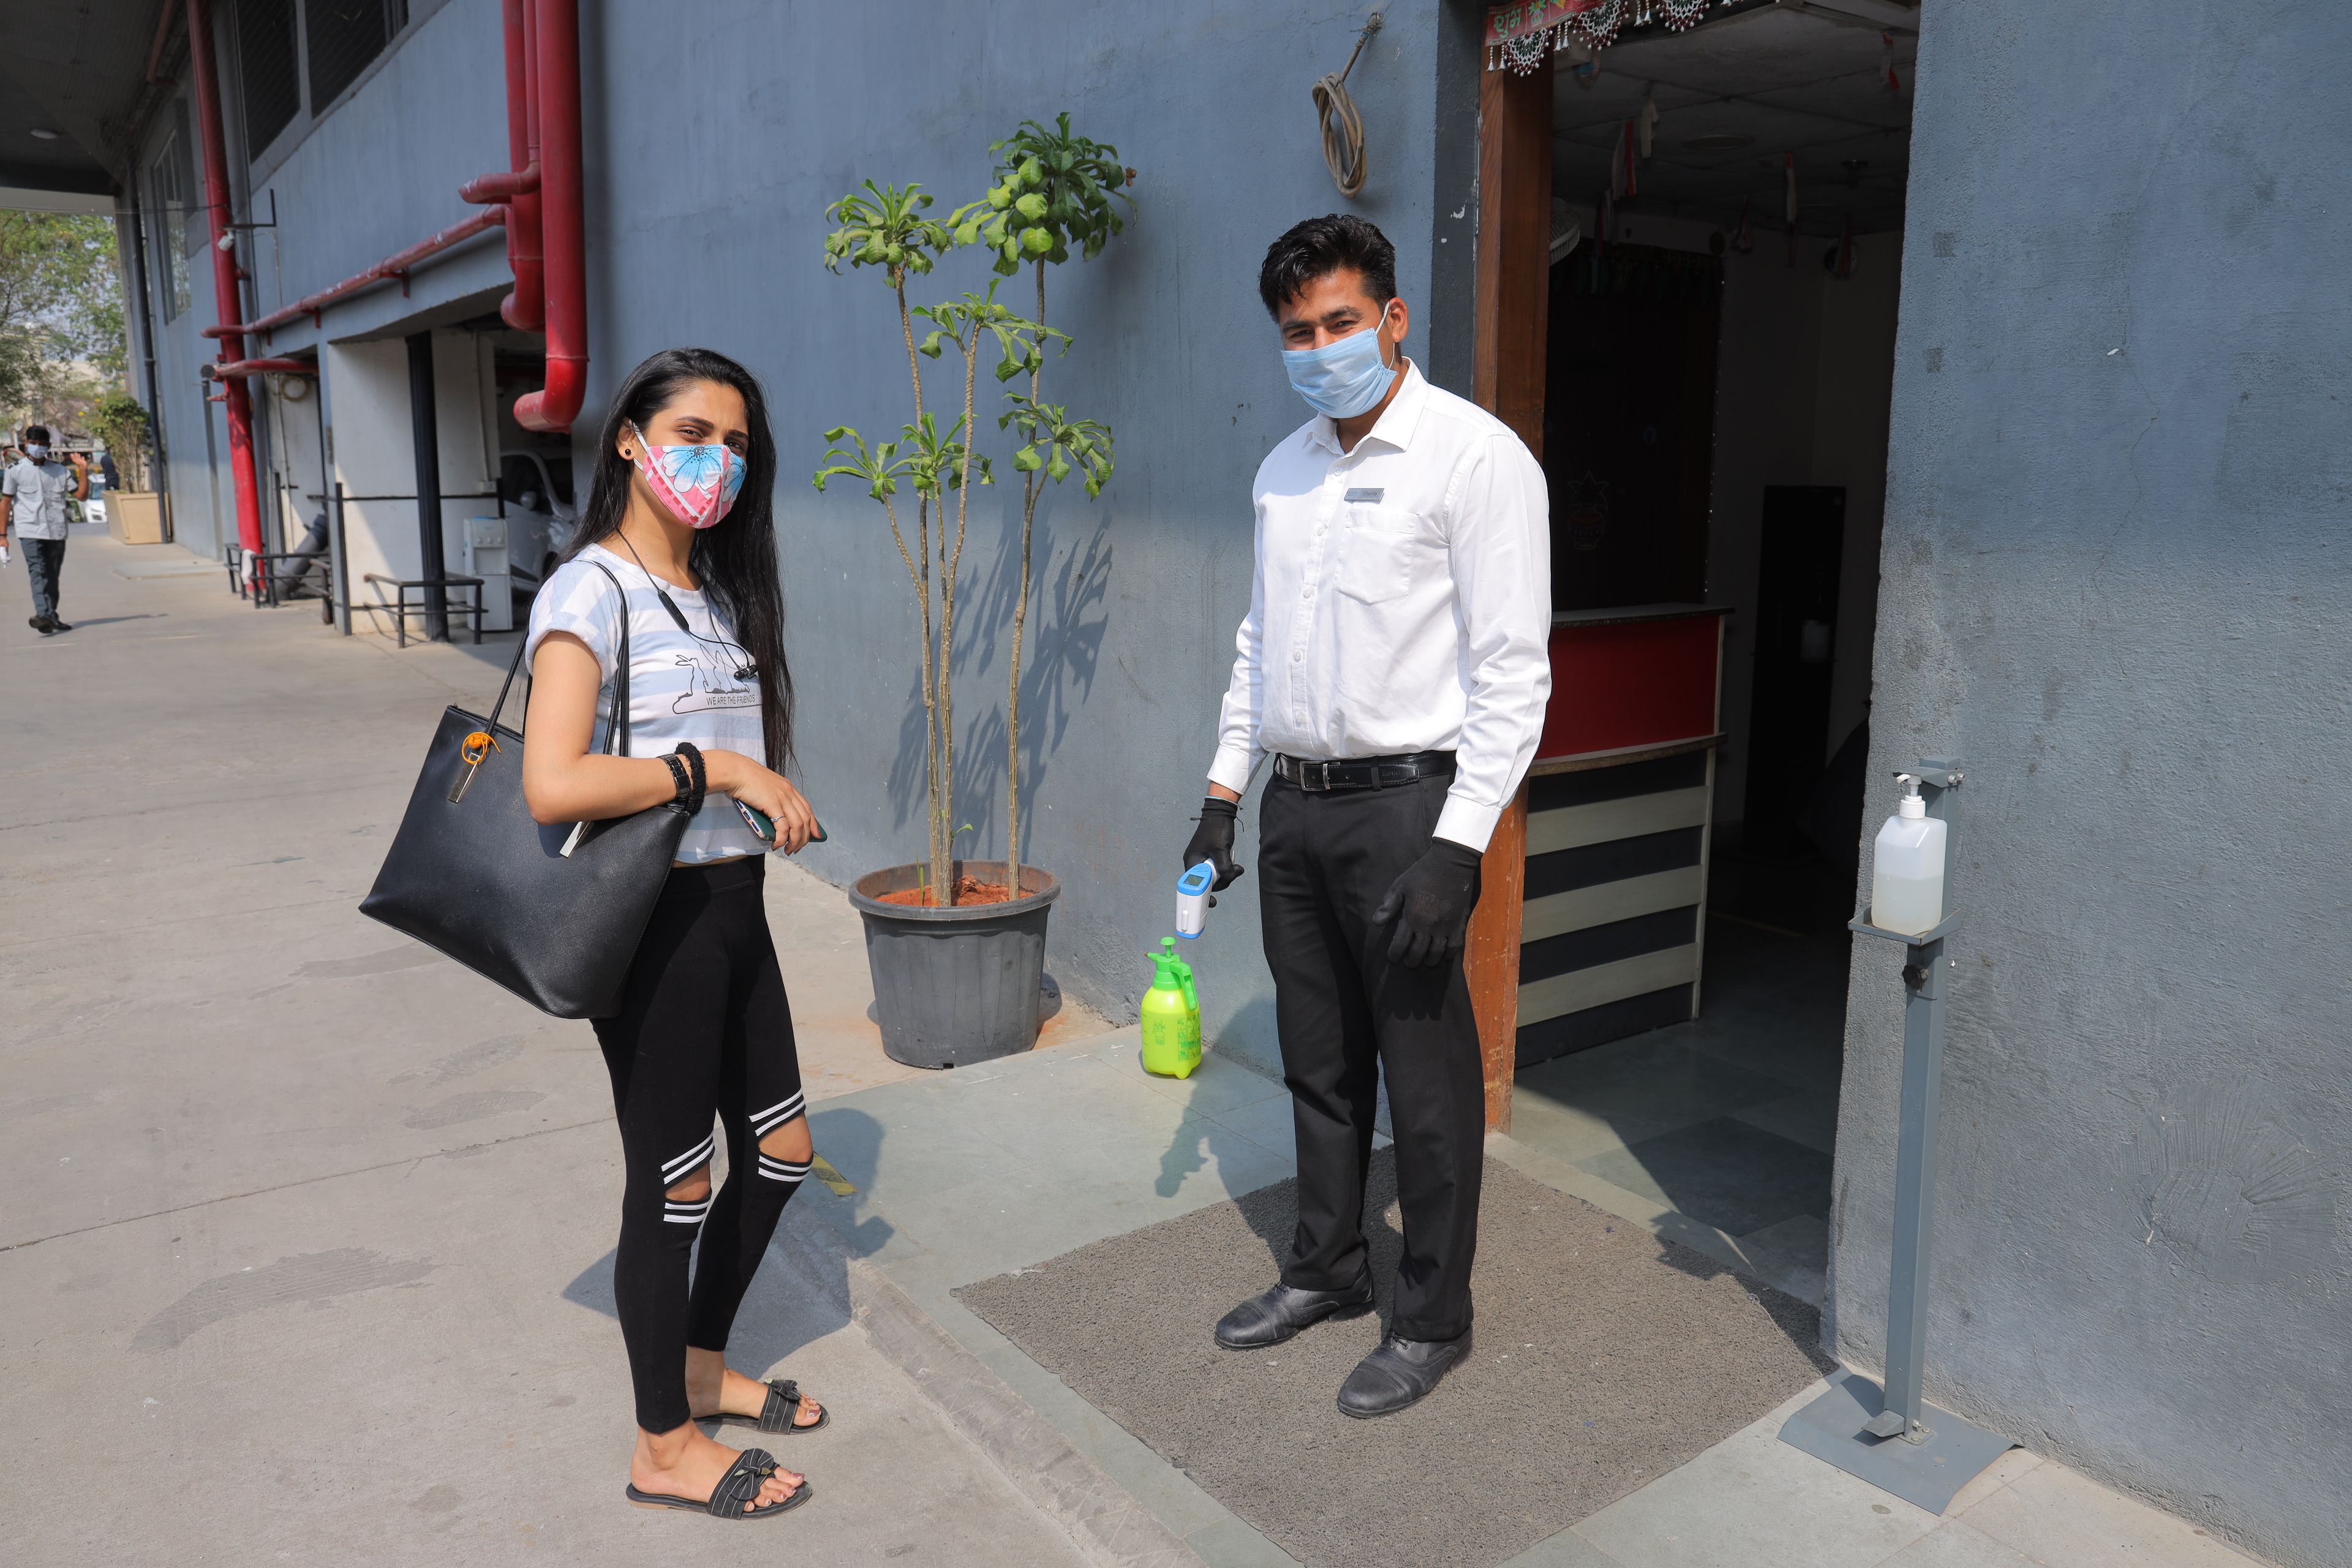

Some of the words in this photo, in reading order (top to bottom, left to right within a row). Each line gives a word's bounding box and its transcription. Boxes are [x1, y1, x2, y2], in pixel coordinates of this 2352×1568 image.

[1494, 7, 1522, 39] शुभ
[706, 696, 716, 705] WE
[737, 695, 755, 704] FRIENDS
